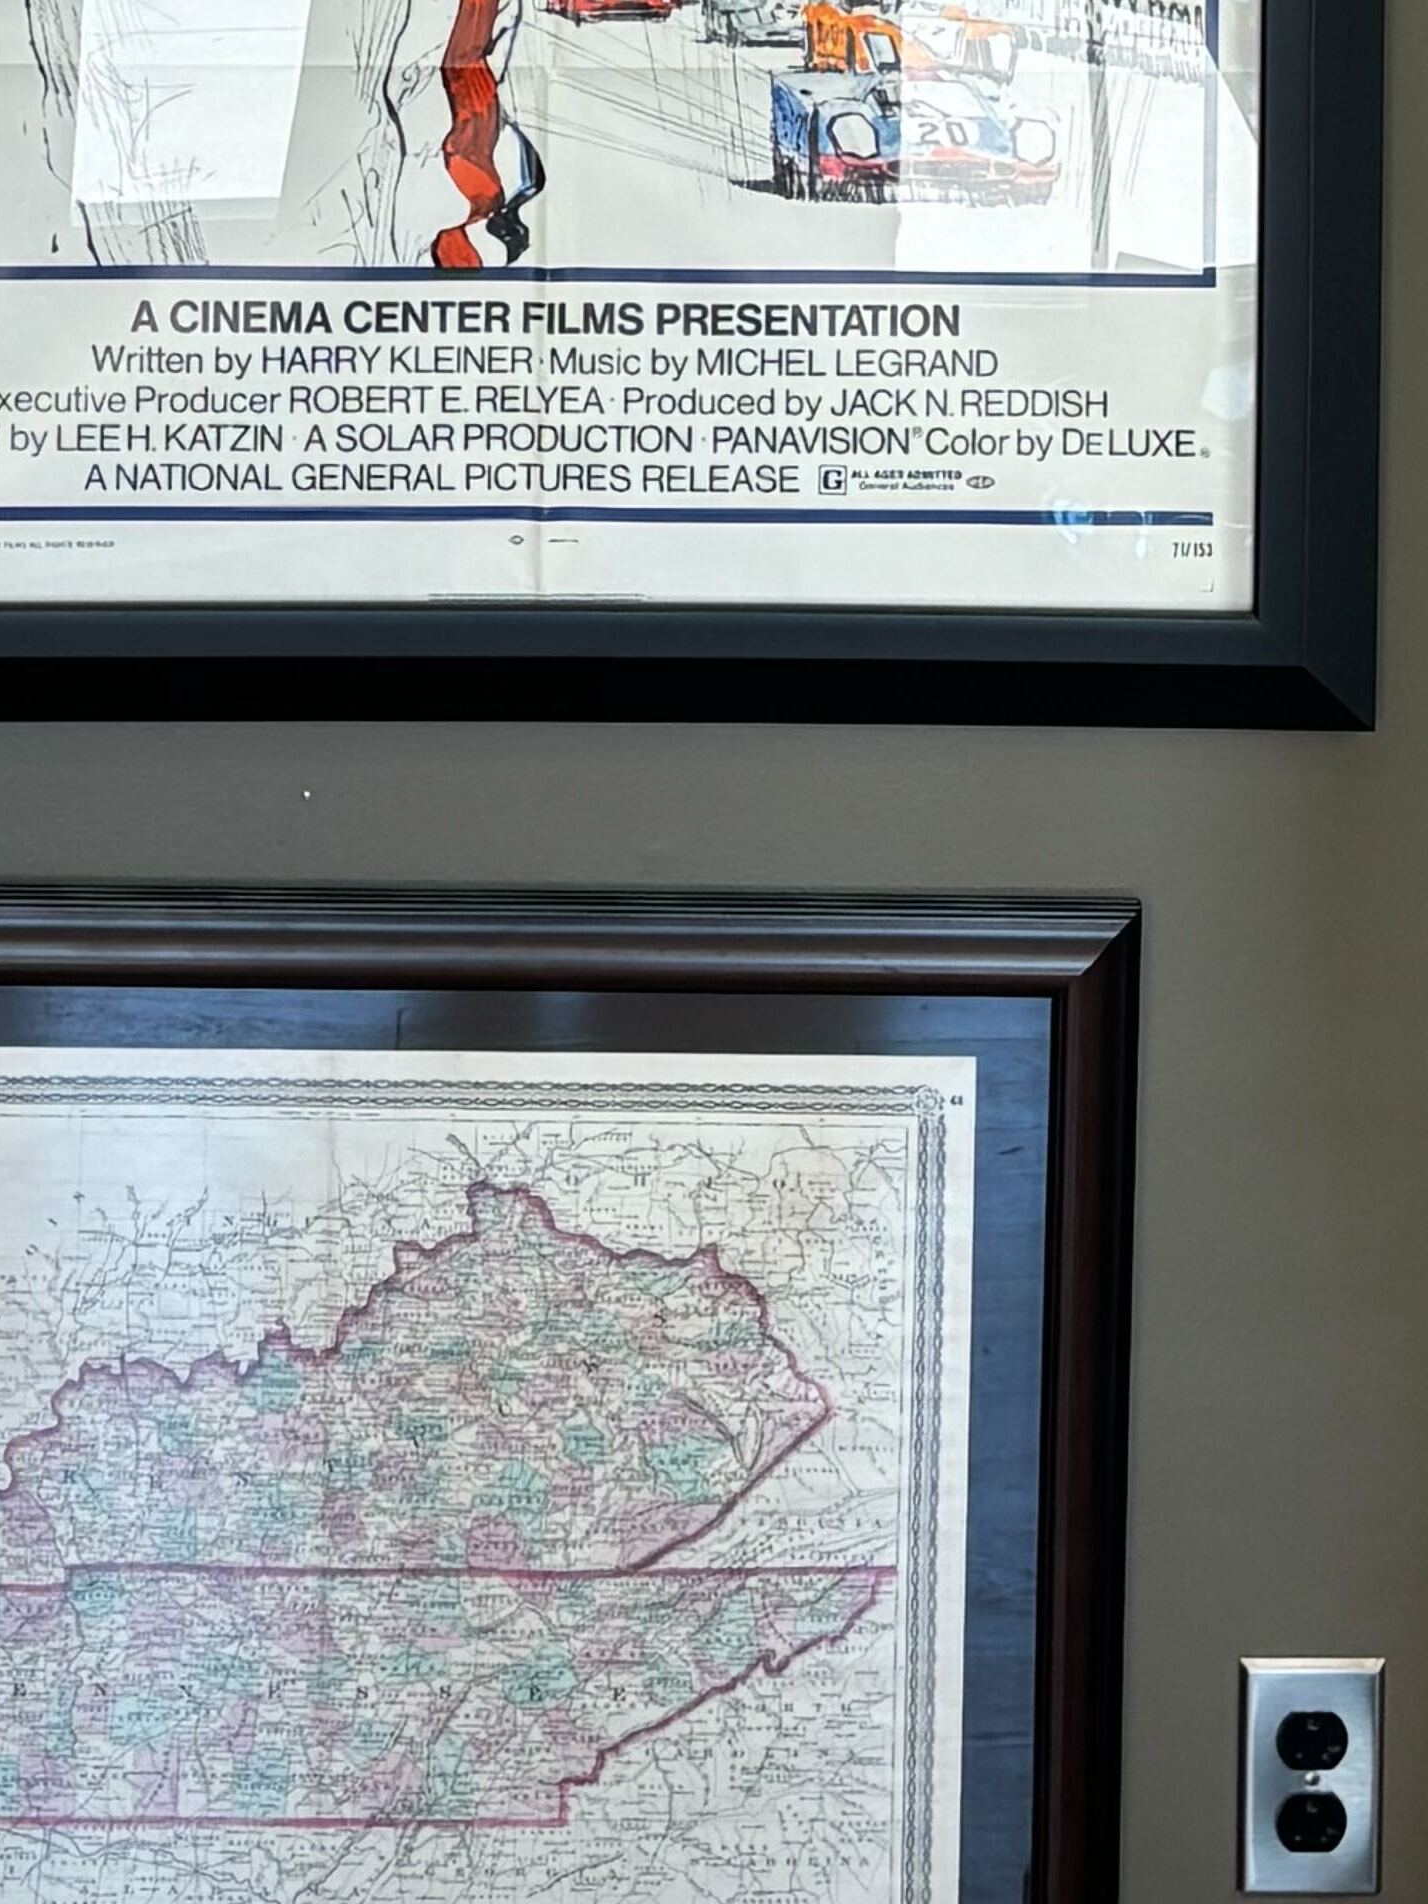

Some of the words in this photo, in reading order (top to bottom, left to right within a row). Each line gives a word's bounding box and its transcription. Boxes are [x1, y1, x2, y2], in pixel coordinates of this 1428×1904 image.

[918, 122, 969, 146] 20
[130, 300, 159, 334] A
[169, 299, 333, 336] CINEMA
[344, 299, 512, 336] CENTER
[521, 301, 644, 337] FILMS
[656, 303, 961, 338] PRESENTATION
[91, 343, 203, 376] Written
[214, 344, 251, 380] by
[261, 345, 379, 376] HARRY
[389, 346, 533, 376] KLEINER
[550, 347, 641, 378] Music
[651, 348, 688, 382] by
[696, 348, 829, 378] MICHEL
[835, 349, 999, 380] LEGRAND
[134, 384, 282, 416] Producer
[289, 385, 433, 415] ROBERT
[441, 386, 470, 415] E.
[476, 386, 605, 416] RELYEA
[623, 387, 775, 418] Produced
[784, 388, 822, 422] by
[830, 388, 920, 418] JACK
[925, 388, 956, 418] N.
[961, 388, 1109, 419] REDDISH
[10, 423, 48, 458] by
[56, 424, 122, 454] LEE
[126, 424, 158, 454] H.
[164, 424, 283, 454] KATZIN
[304, 425, 329, 453] A
[336, 424, 456, 455] SOLAR
[463, 424, 693, 456] PRODUCTION
[924, 427, 1011, 458] Color
[1017, 428, 1053, 464] by
[84, 463, 106, 491] A
[114, 463, 282, 492] NATIONAL
[291, 463, 456, 493] GENERAL
[465, 463, 632, 493] PICTURES
[642, 465, 799, 494] RELEASE
[823, 470, 842, 490] G
